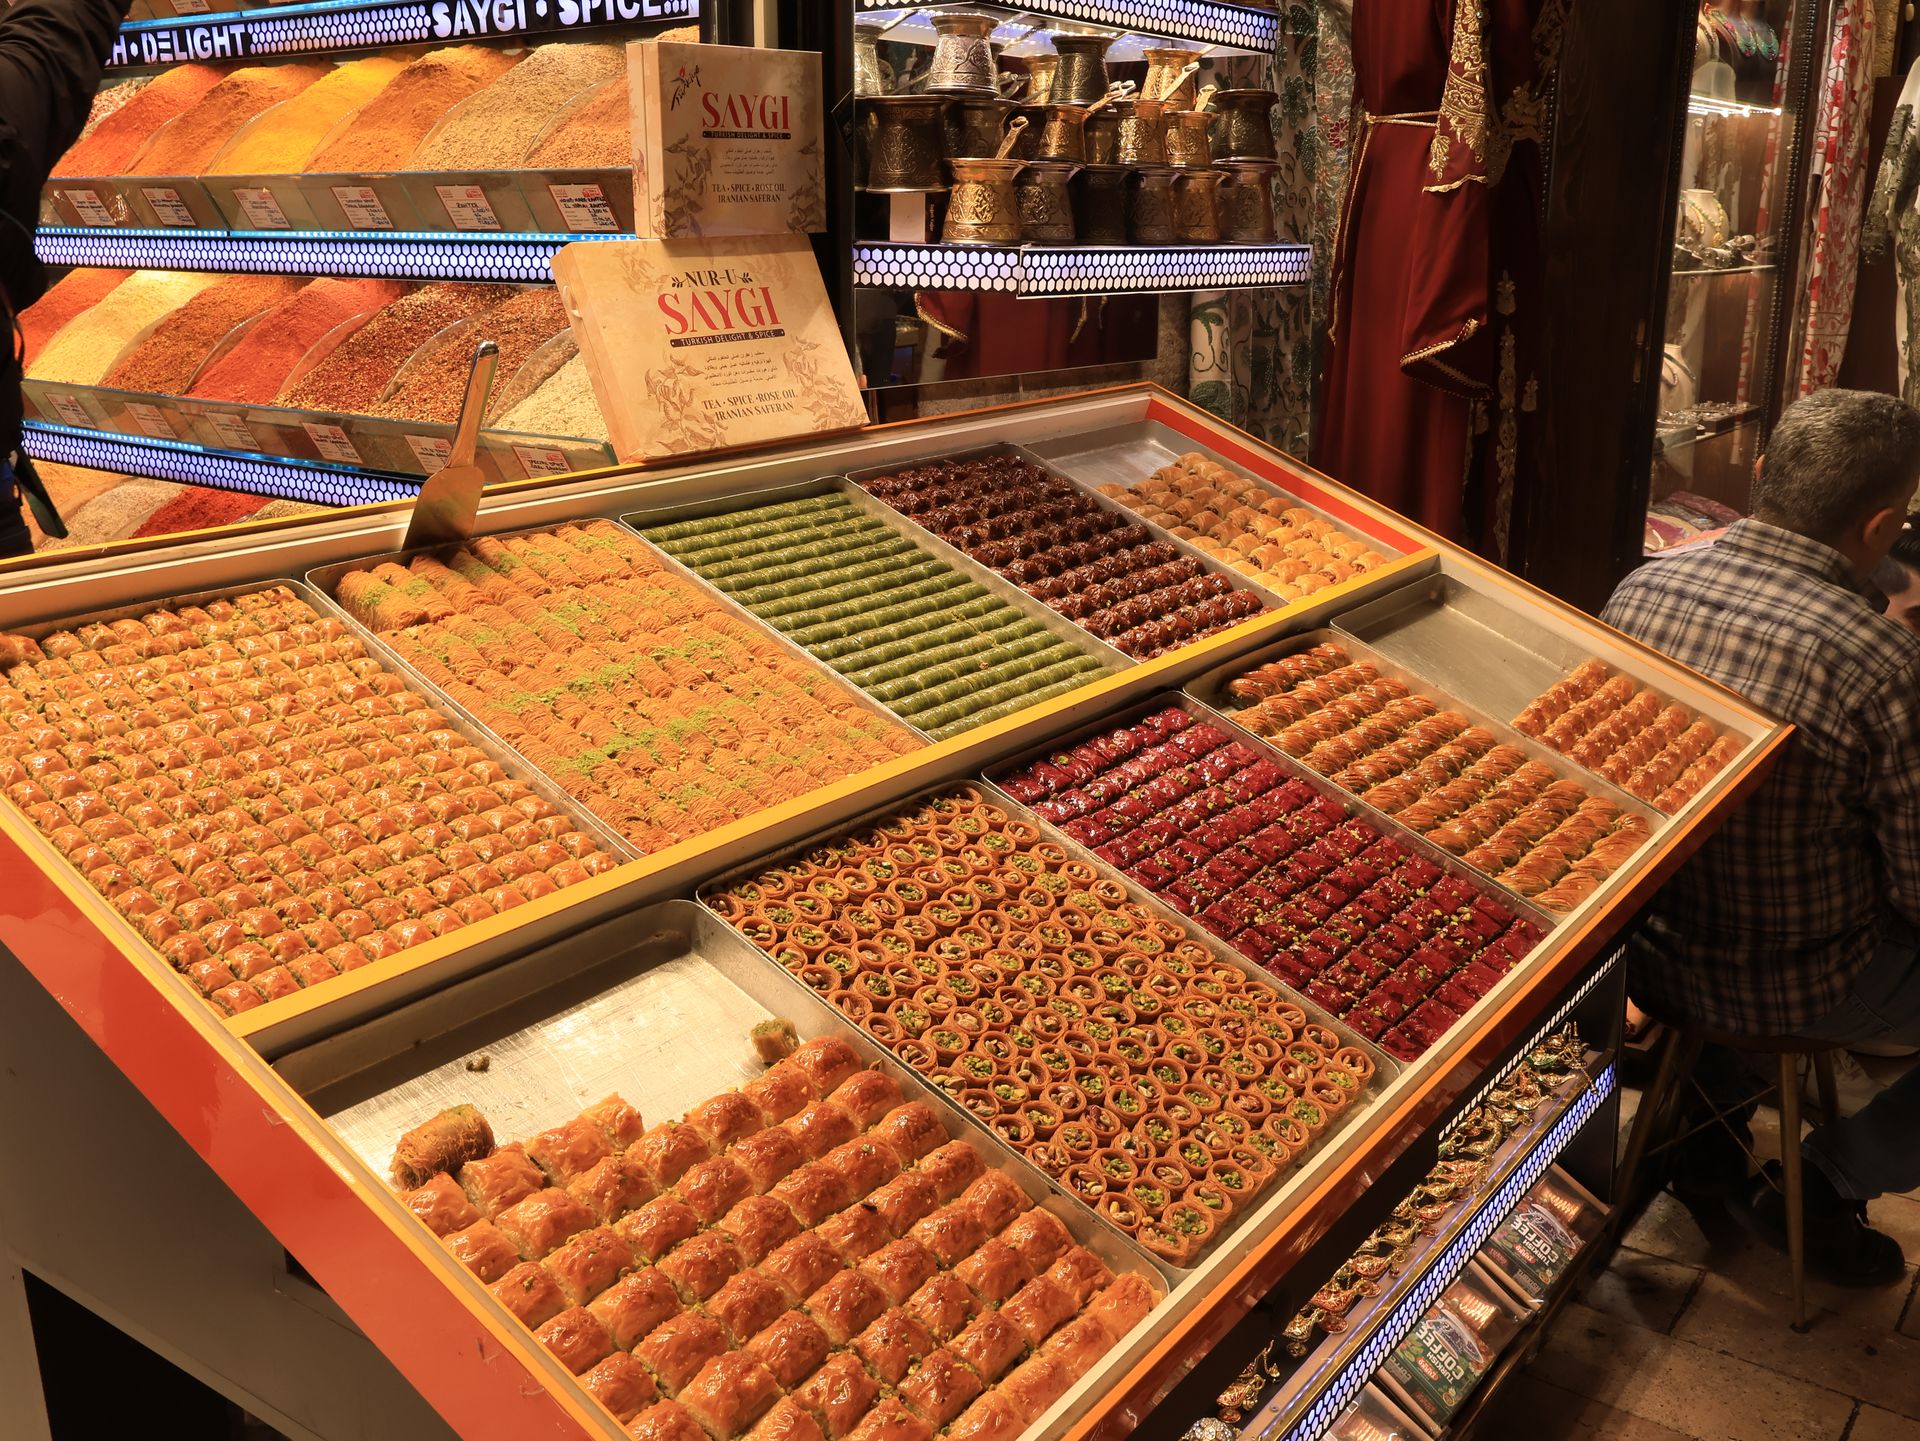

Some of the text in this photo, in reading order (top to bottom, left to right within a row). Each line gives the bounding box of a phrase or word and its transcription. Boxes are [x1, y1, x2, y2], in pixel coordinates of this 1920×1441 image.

[431, 0, 527, 38] SAYGI
[141, 24, 245, 62] DELIGHT
[702, 92, 790, 130] SAYGI
[712, 183, 786, 193] TEA SPICE ROSE OIL
[718, 193, 780, 204] IRANIAN SAFERAN
[685, 269, 737, 287] NUR-U
[657, 287, 781, 335] SAYGI
[681, 337, 713, 347] TURKISH
[715, 333, 746, 343] DELIGHT
[755, 331, 775, 339] SPICE
[703, 389, 796, 410] TEA SPICE ROSE OIL
[715, 401, 794, 421] IRANIAN SAFERAN
[1511, 1215, 1559, 1263] COFFEE
[1522, 1239, 1551, 1266] TURKISH
[1416, 1323, 1464, 1380] COFFEE
[1427, 1351, 1454, 1384] TURKISH
